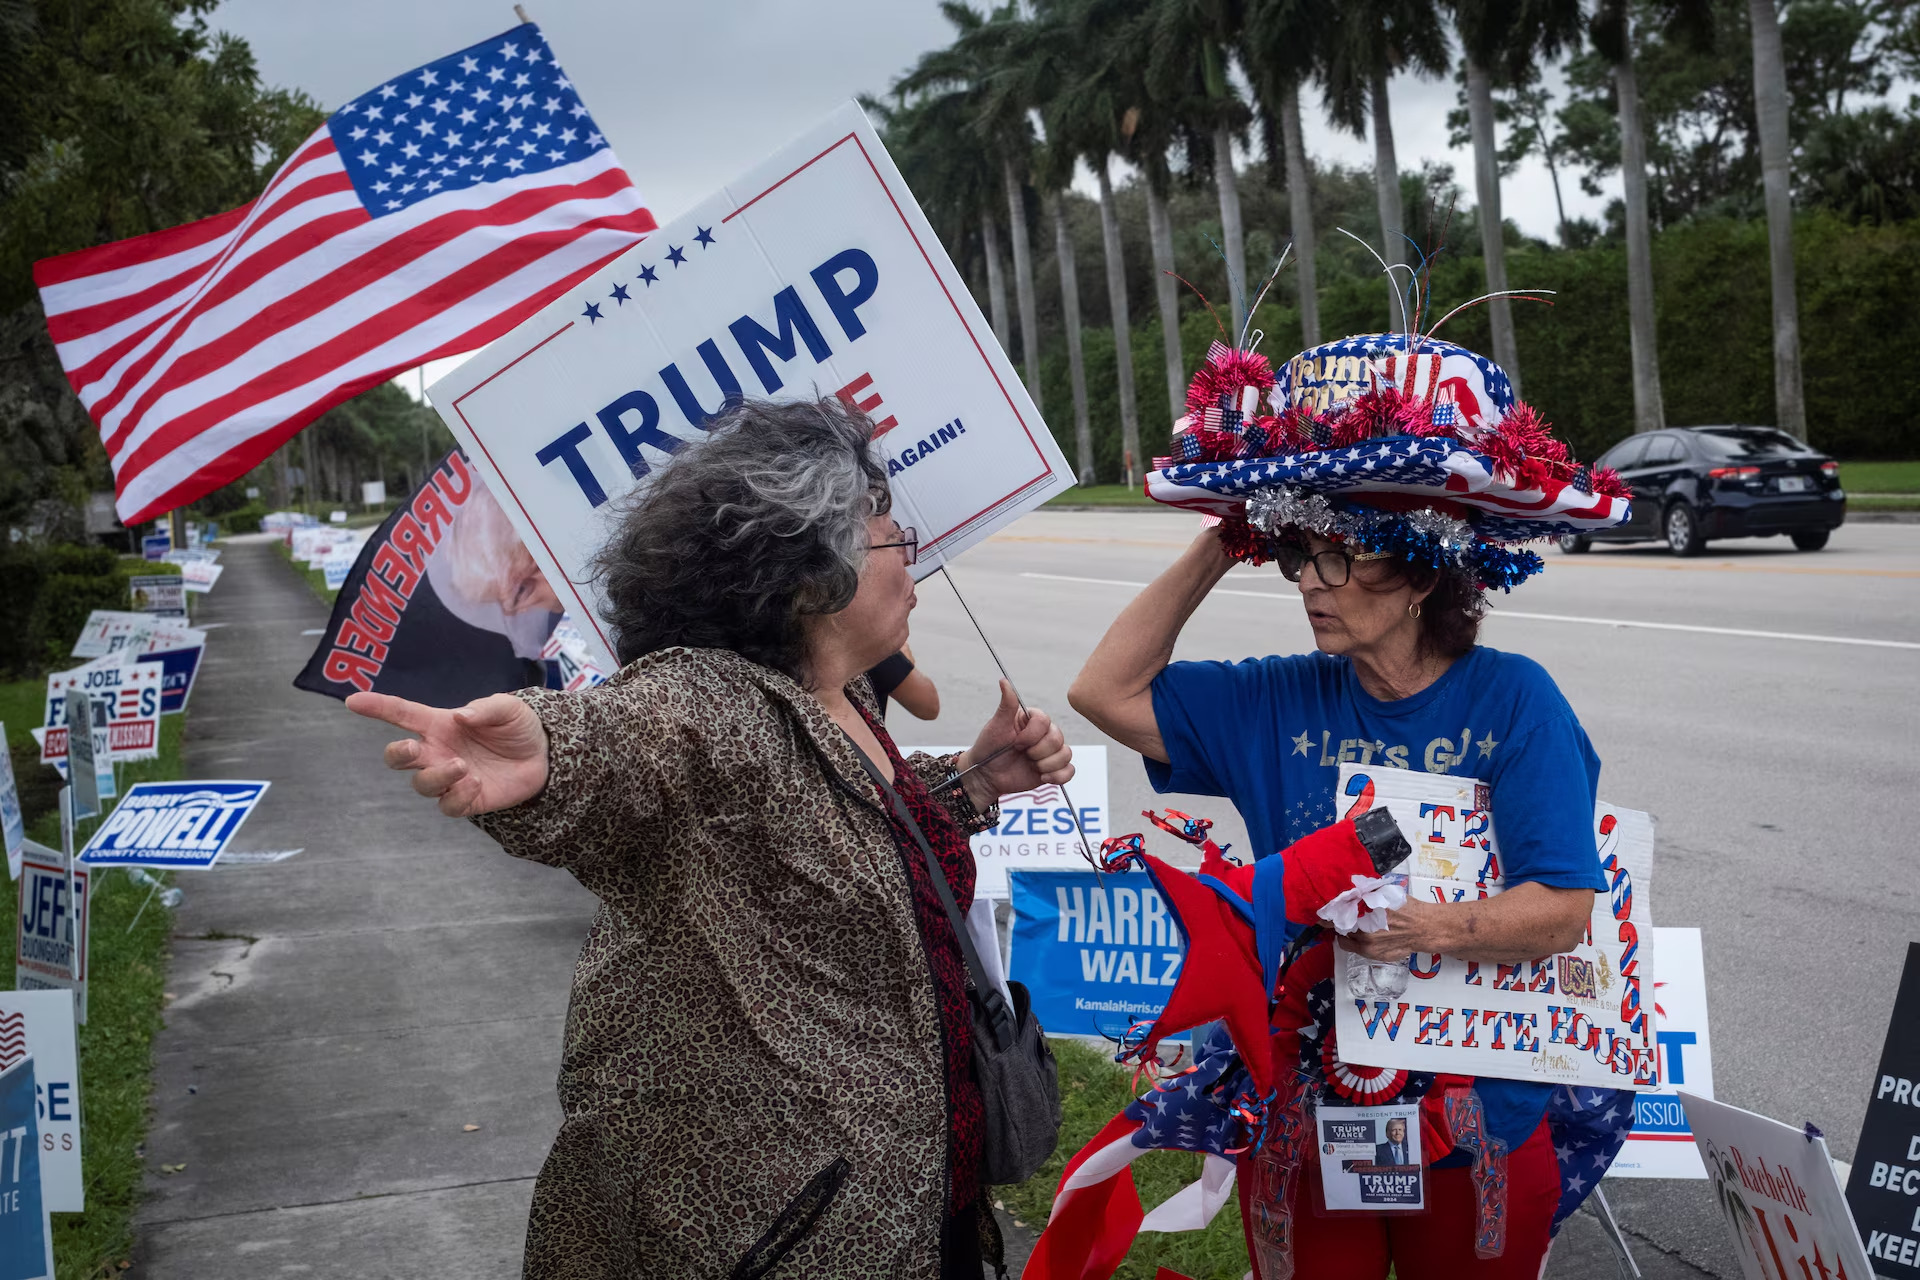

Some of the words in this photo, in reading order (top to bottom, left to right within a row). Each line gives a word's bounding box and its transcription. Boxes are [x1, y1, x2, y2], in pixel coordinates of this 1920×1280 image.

[535, 248, 879, 508] TRUMP
[1290, 353, 1370, 387] Trum
[888, 418, 966, 478] AGAIN!
[84, 669, 122, 690] JOEL
[47, 687, 156, 727] FRES
[1319, 730, 1410, 770] LET'S
[90, 807, 237, 850] POWELL
[976, 807, 1101, 836] ZESE
[980, 841, 1101, 858] ONGRESS
[1056, 886, 1178, 947] HARR
[1080, 949, 1182, 986] WALZ
[1558, 956, 1596, 999] USA
[1075, 998, 1165, 1014] KamalaHarris.co
[1355, 999, 1540, 1053] WHITE
[1547, 1005, 1657, 1086] HOUSE
[1362, 1175, 1417, 1186] TRUMP
[1369, 1186, 1411, 1194] VANCE
[1729, 1145, 1812, 1216] Rachelle
